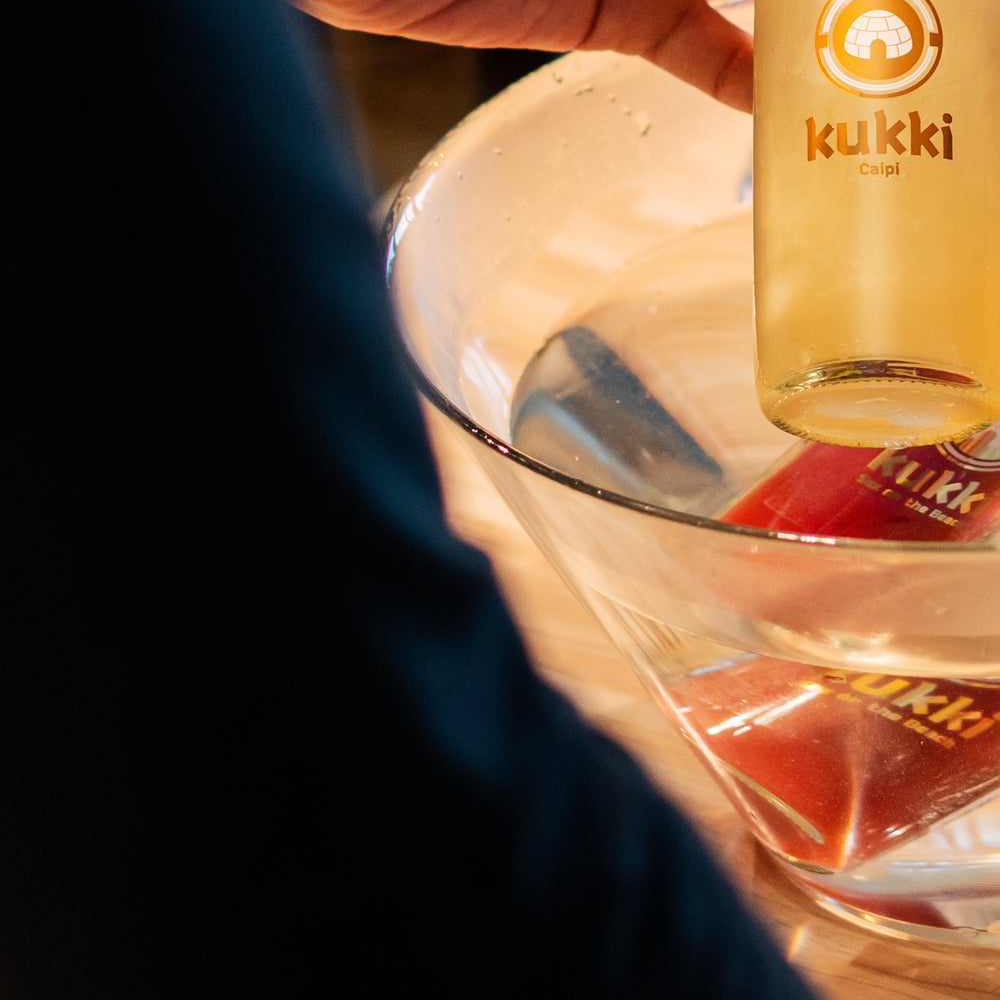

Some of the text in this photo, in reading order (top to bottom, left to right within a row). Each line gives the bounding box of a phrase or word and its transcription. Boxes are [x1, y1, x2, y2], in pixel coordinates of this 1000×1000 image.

[805, 110, 954, 162] kukki
[859, 162, 901, 177] Caipi
[904, 497, 930, 515] the
